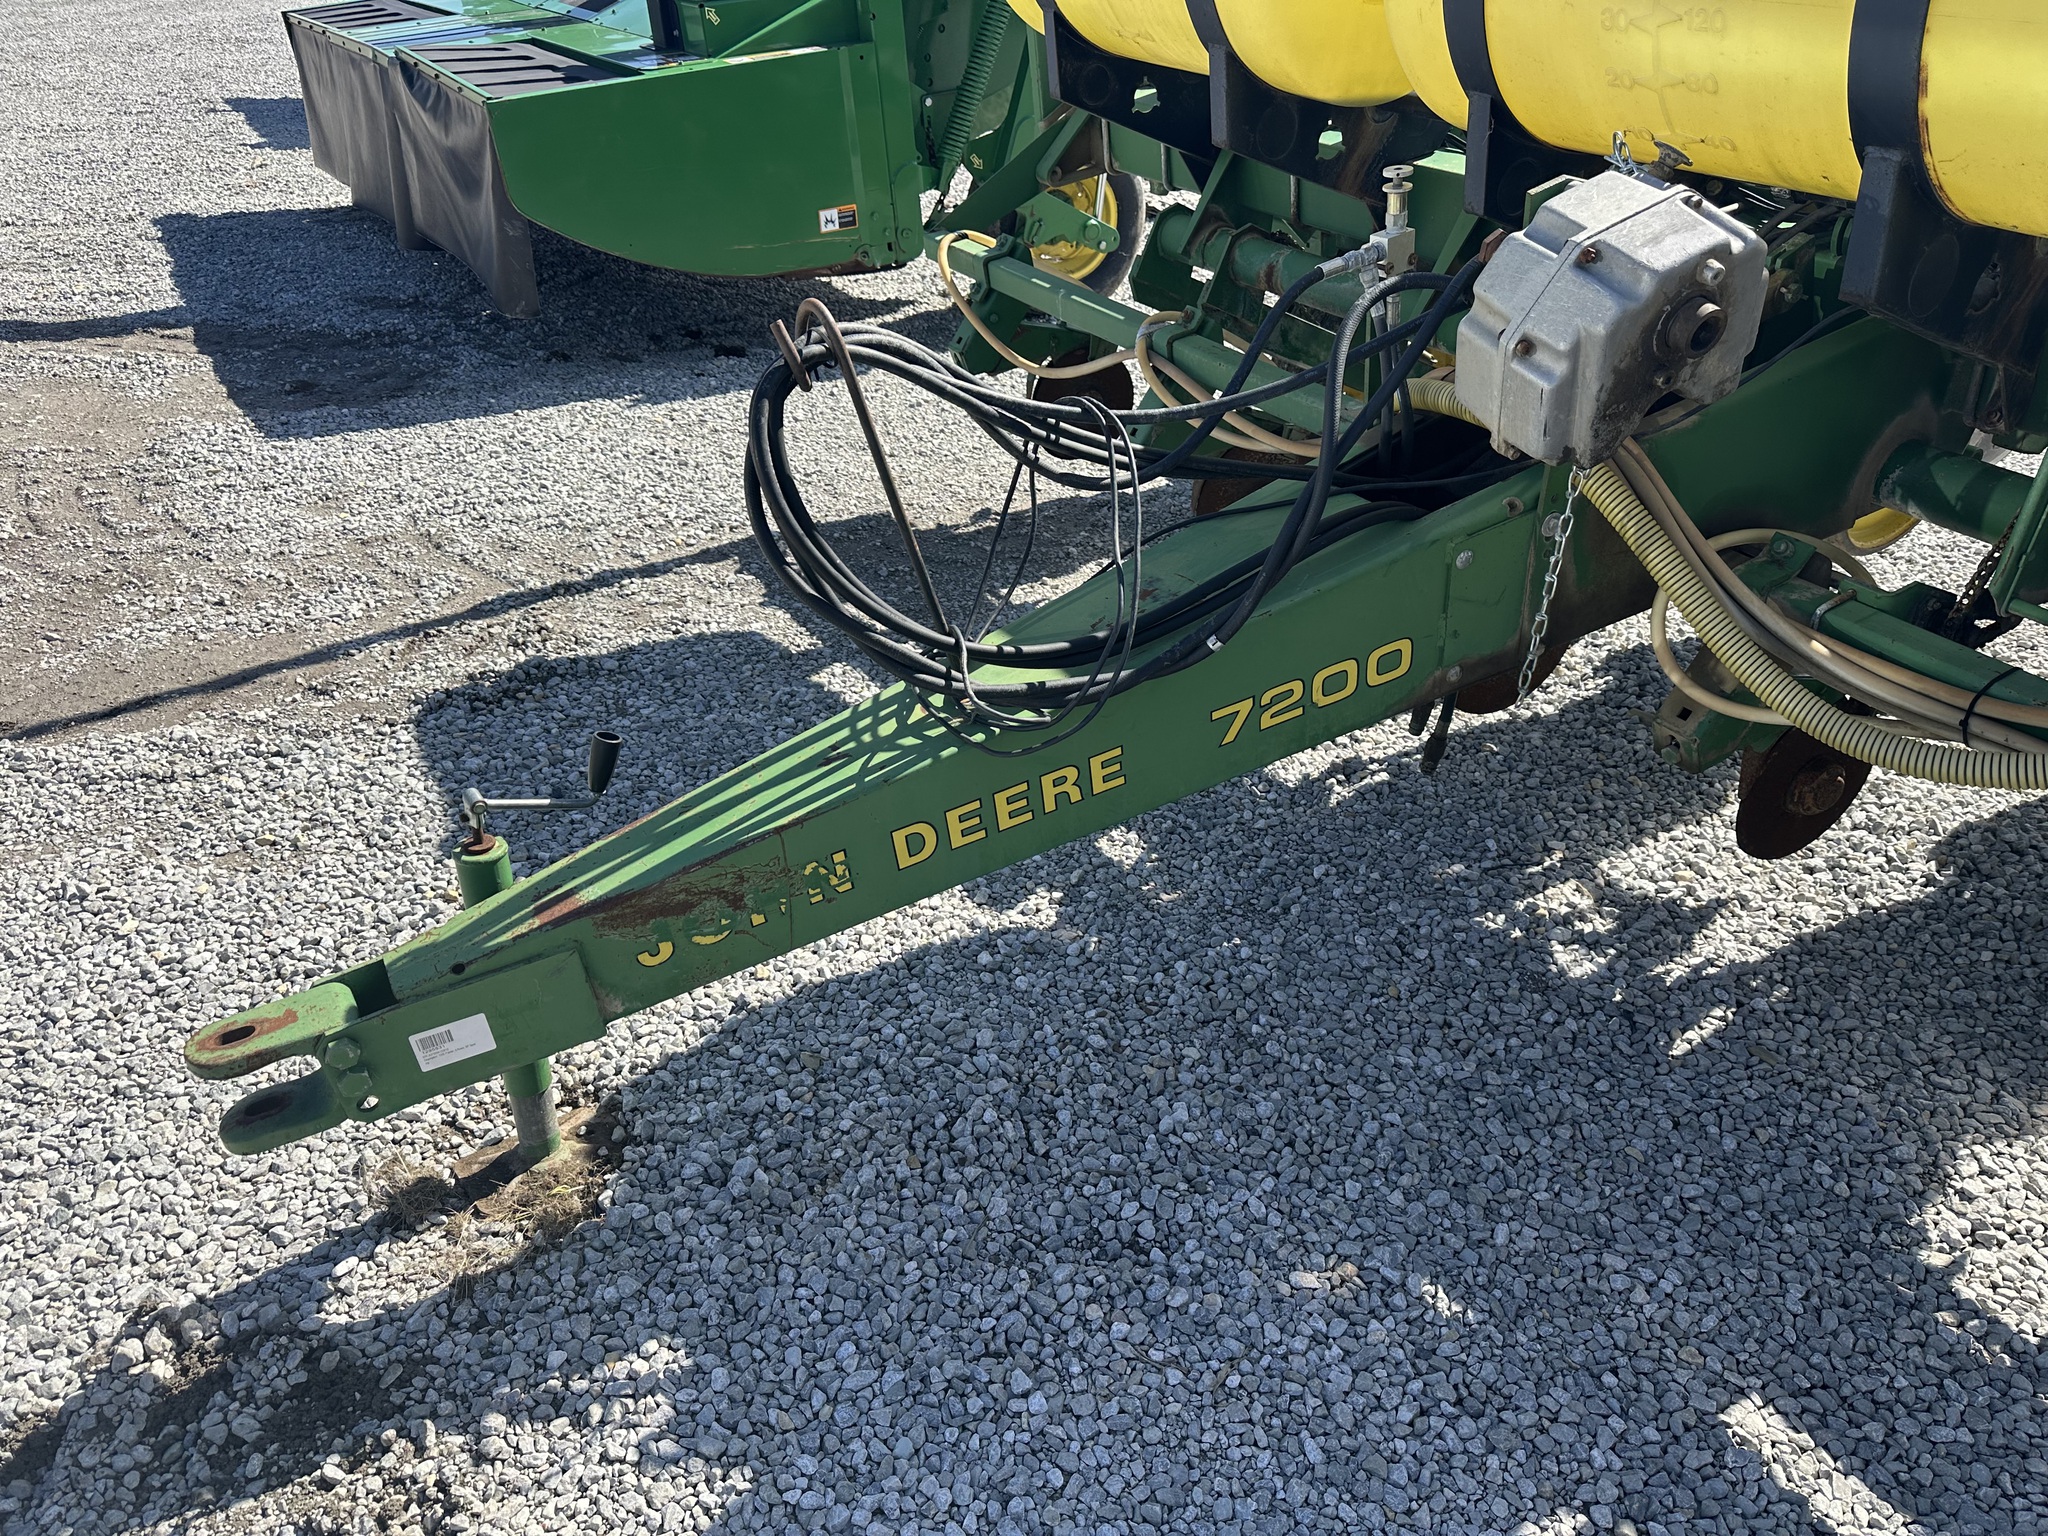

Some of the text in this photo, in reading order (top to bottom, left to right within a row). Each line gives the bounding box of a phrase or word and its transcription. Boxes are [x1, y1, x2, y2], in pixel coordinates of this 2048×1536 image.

[1600, 7, 1630, 33] 30
[1683, 7, 1726, 33] 120
[1604, 66, 1635, 90] 20
[1684, 72, 1719, 95] 80
[637, 636, 1413, 967] JN DEERE 7200
